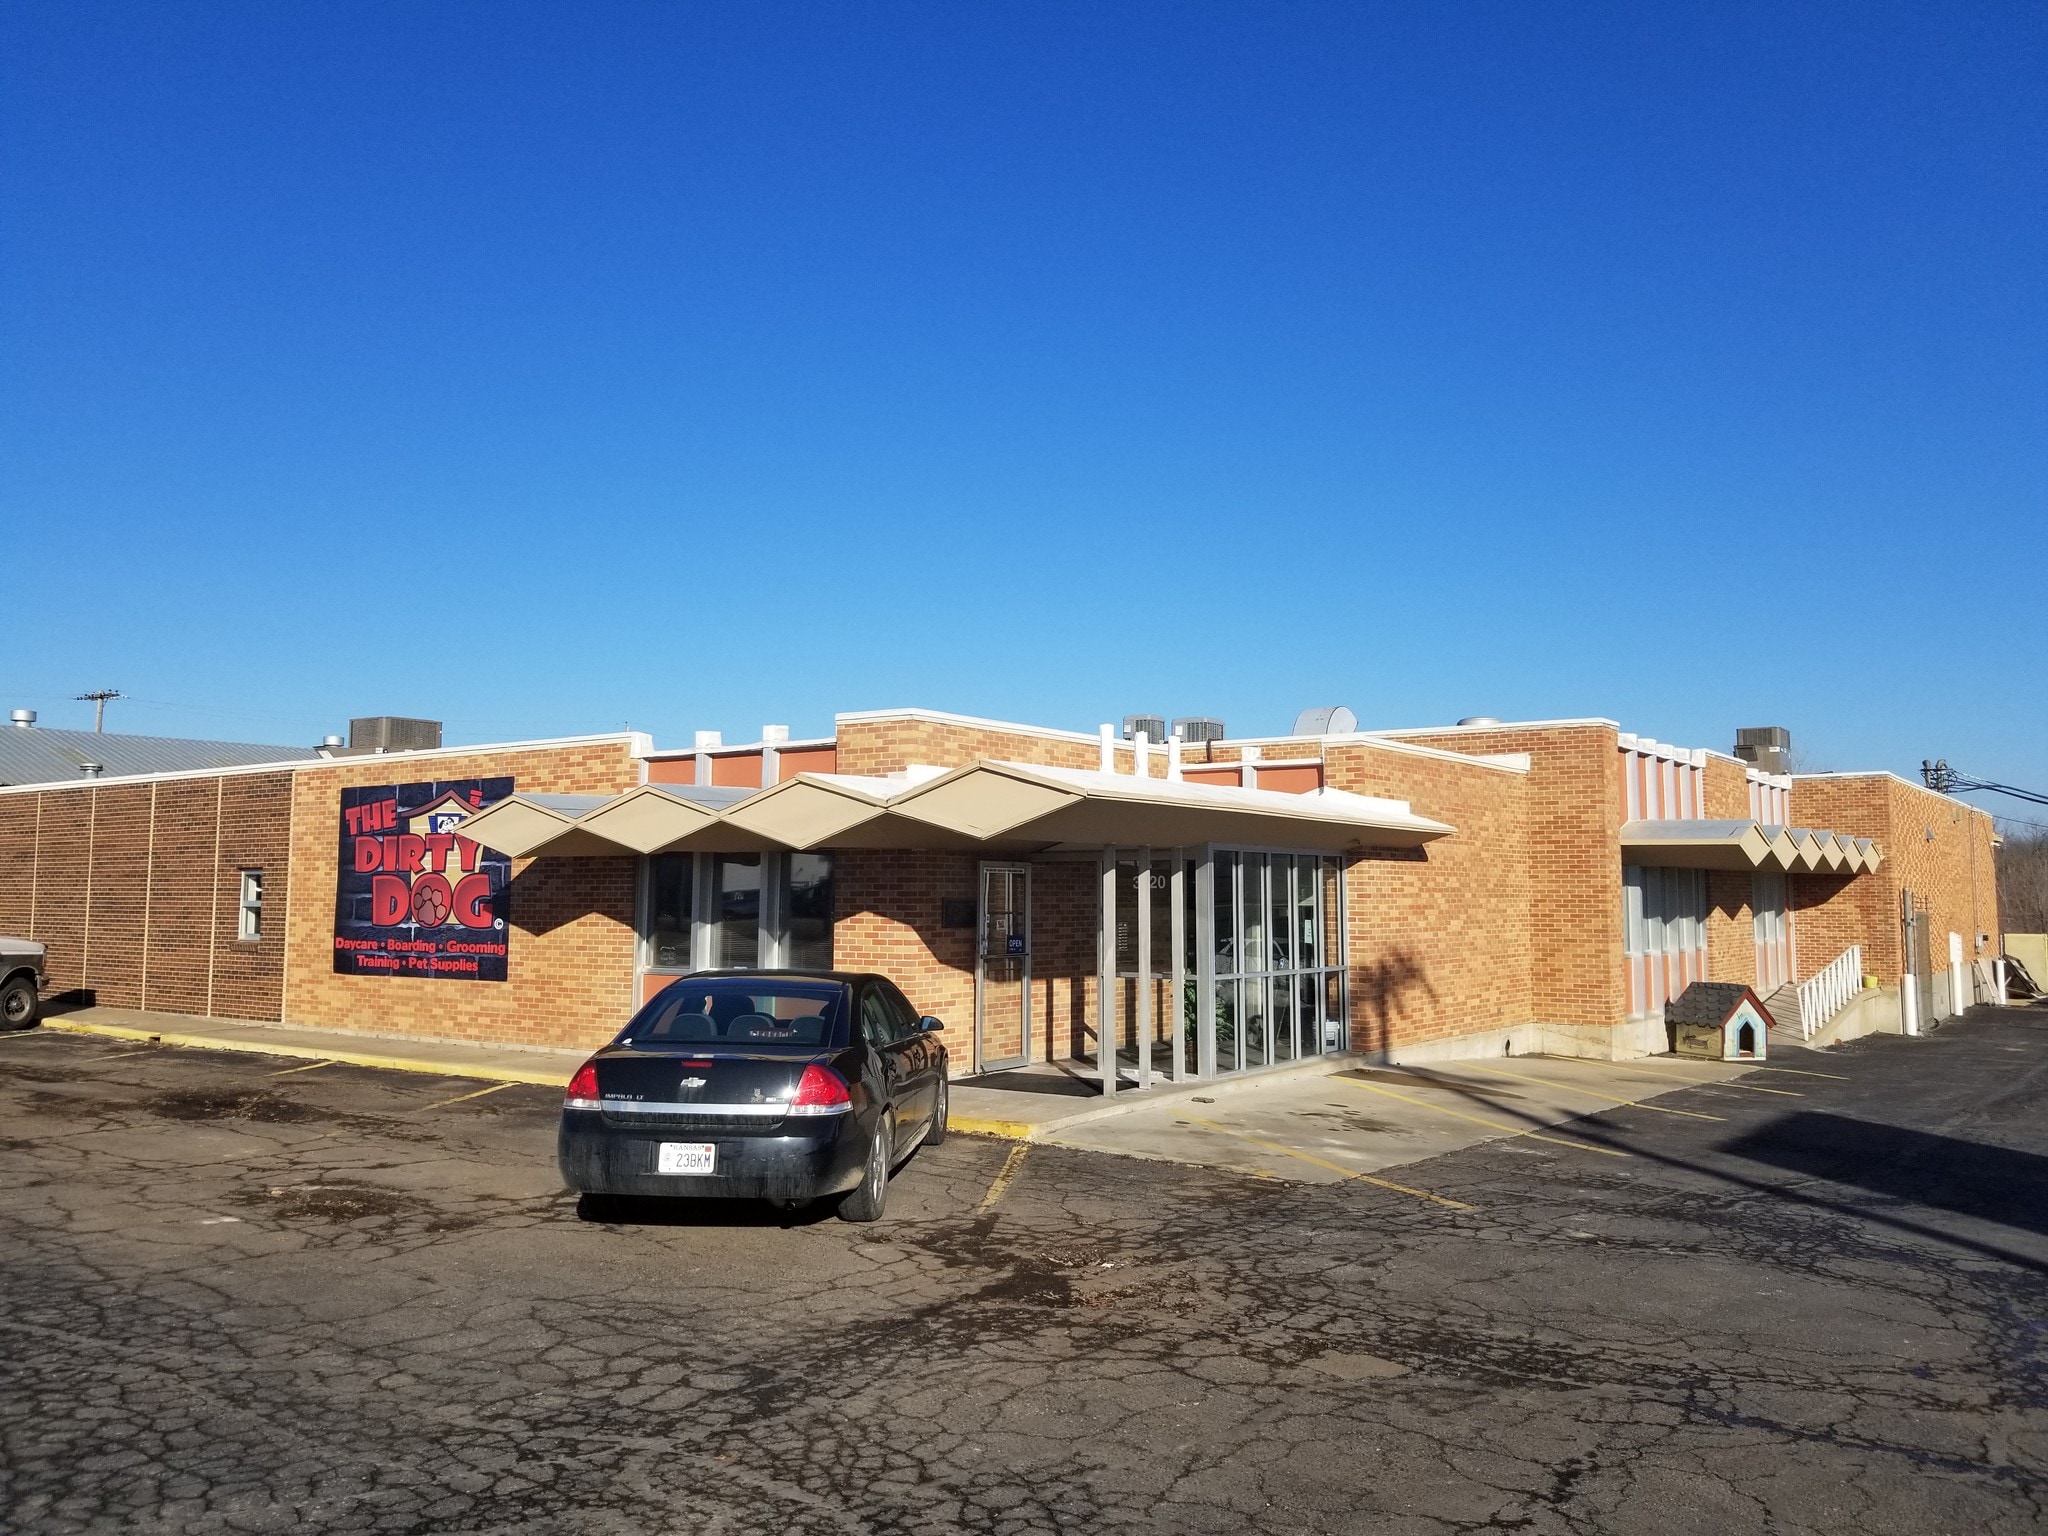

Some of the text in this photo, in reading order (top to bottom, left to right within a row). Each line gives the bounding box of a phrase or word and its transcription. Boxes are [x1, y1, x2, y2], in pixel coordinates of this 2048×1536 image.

[345, 799, 397, 835] THE
[355, 833, 480, 873] DIRTY
[1133, 875, 1166, 889] 320
[372, 873, 494, 929] DOG
[335, 937, 506, 956] Daycare Boarding Grooming
[1008, 939, 1023, 948] OPEN
[356, 955, 478, 972] Training Pet Supplies
